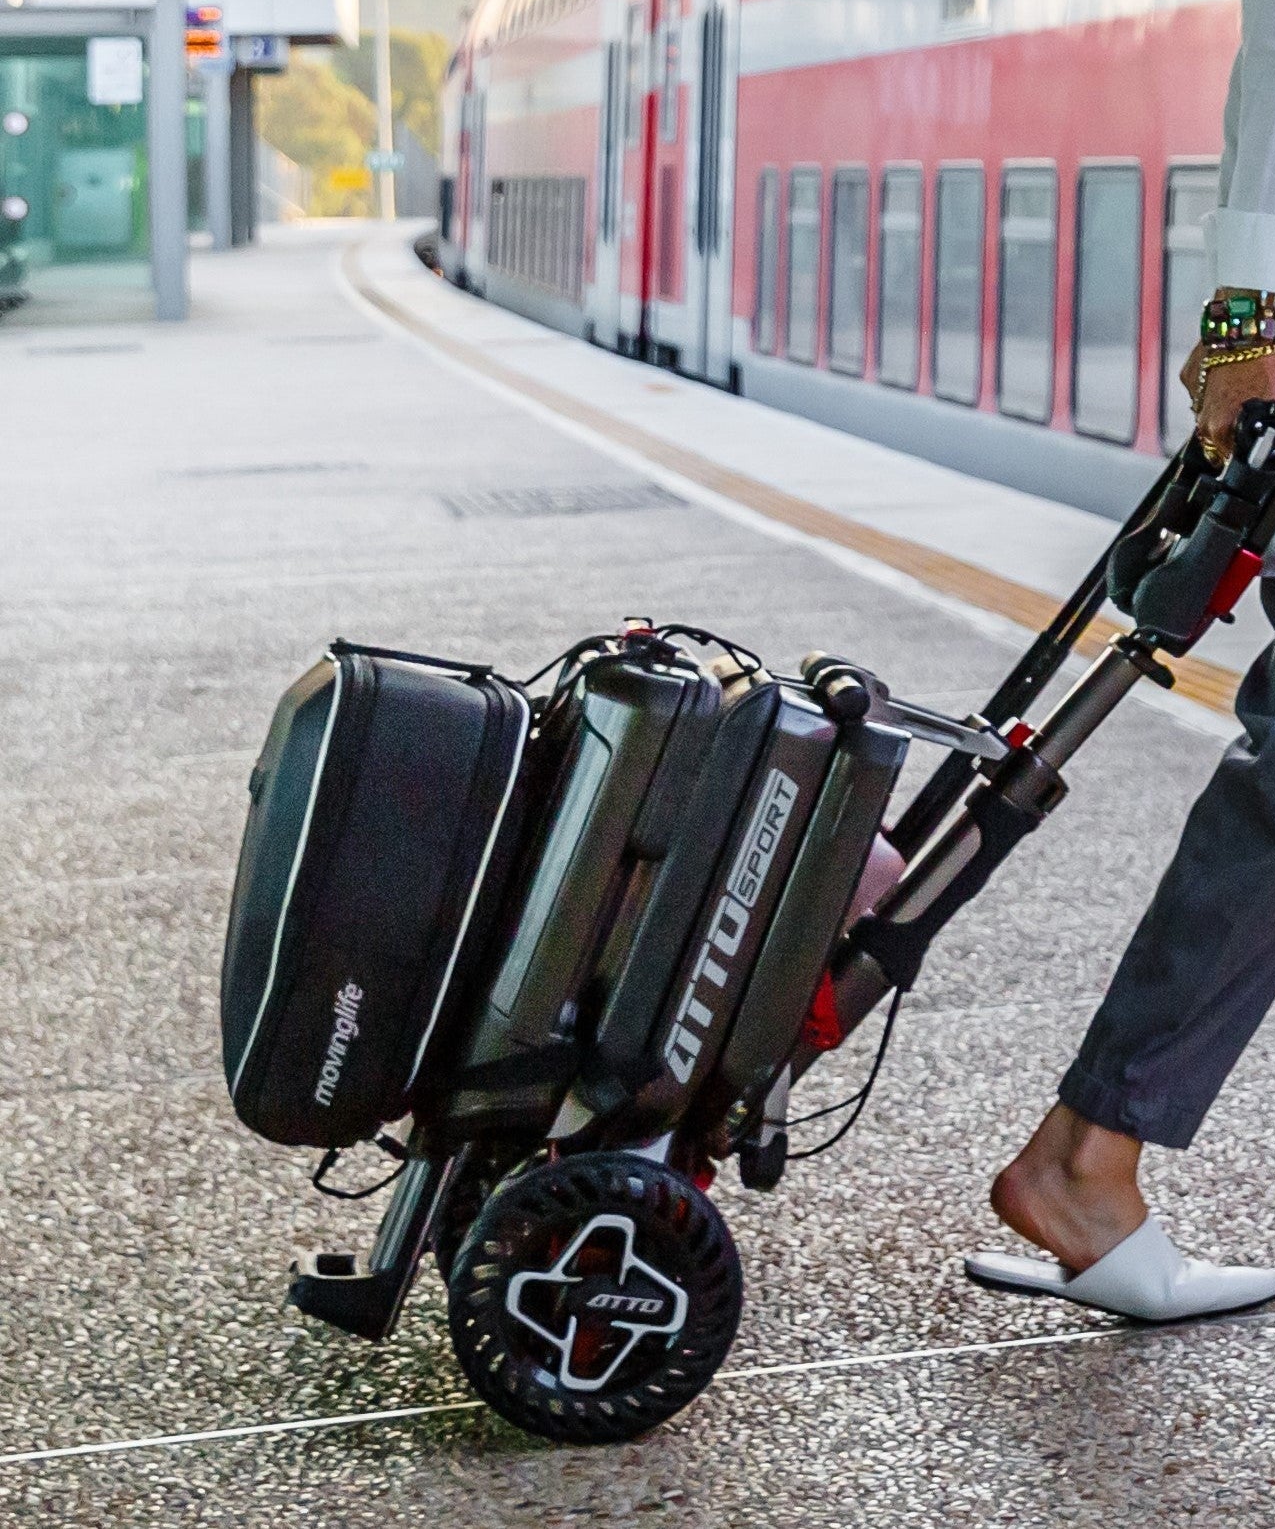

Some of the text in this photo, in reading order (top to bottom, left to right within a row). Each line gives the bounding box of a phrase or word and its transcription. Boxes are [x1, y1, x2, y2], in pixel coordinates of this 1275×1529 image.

[664, 777, 793, 1085] ATTO SPORT
[314, 981, 364, 1106] movinglife
[586, 1293, 664, 1313] ATTO
